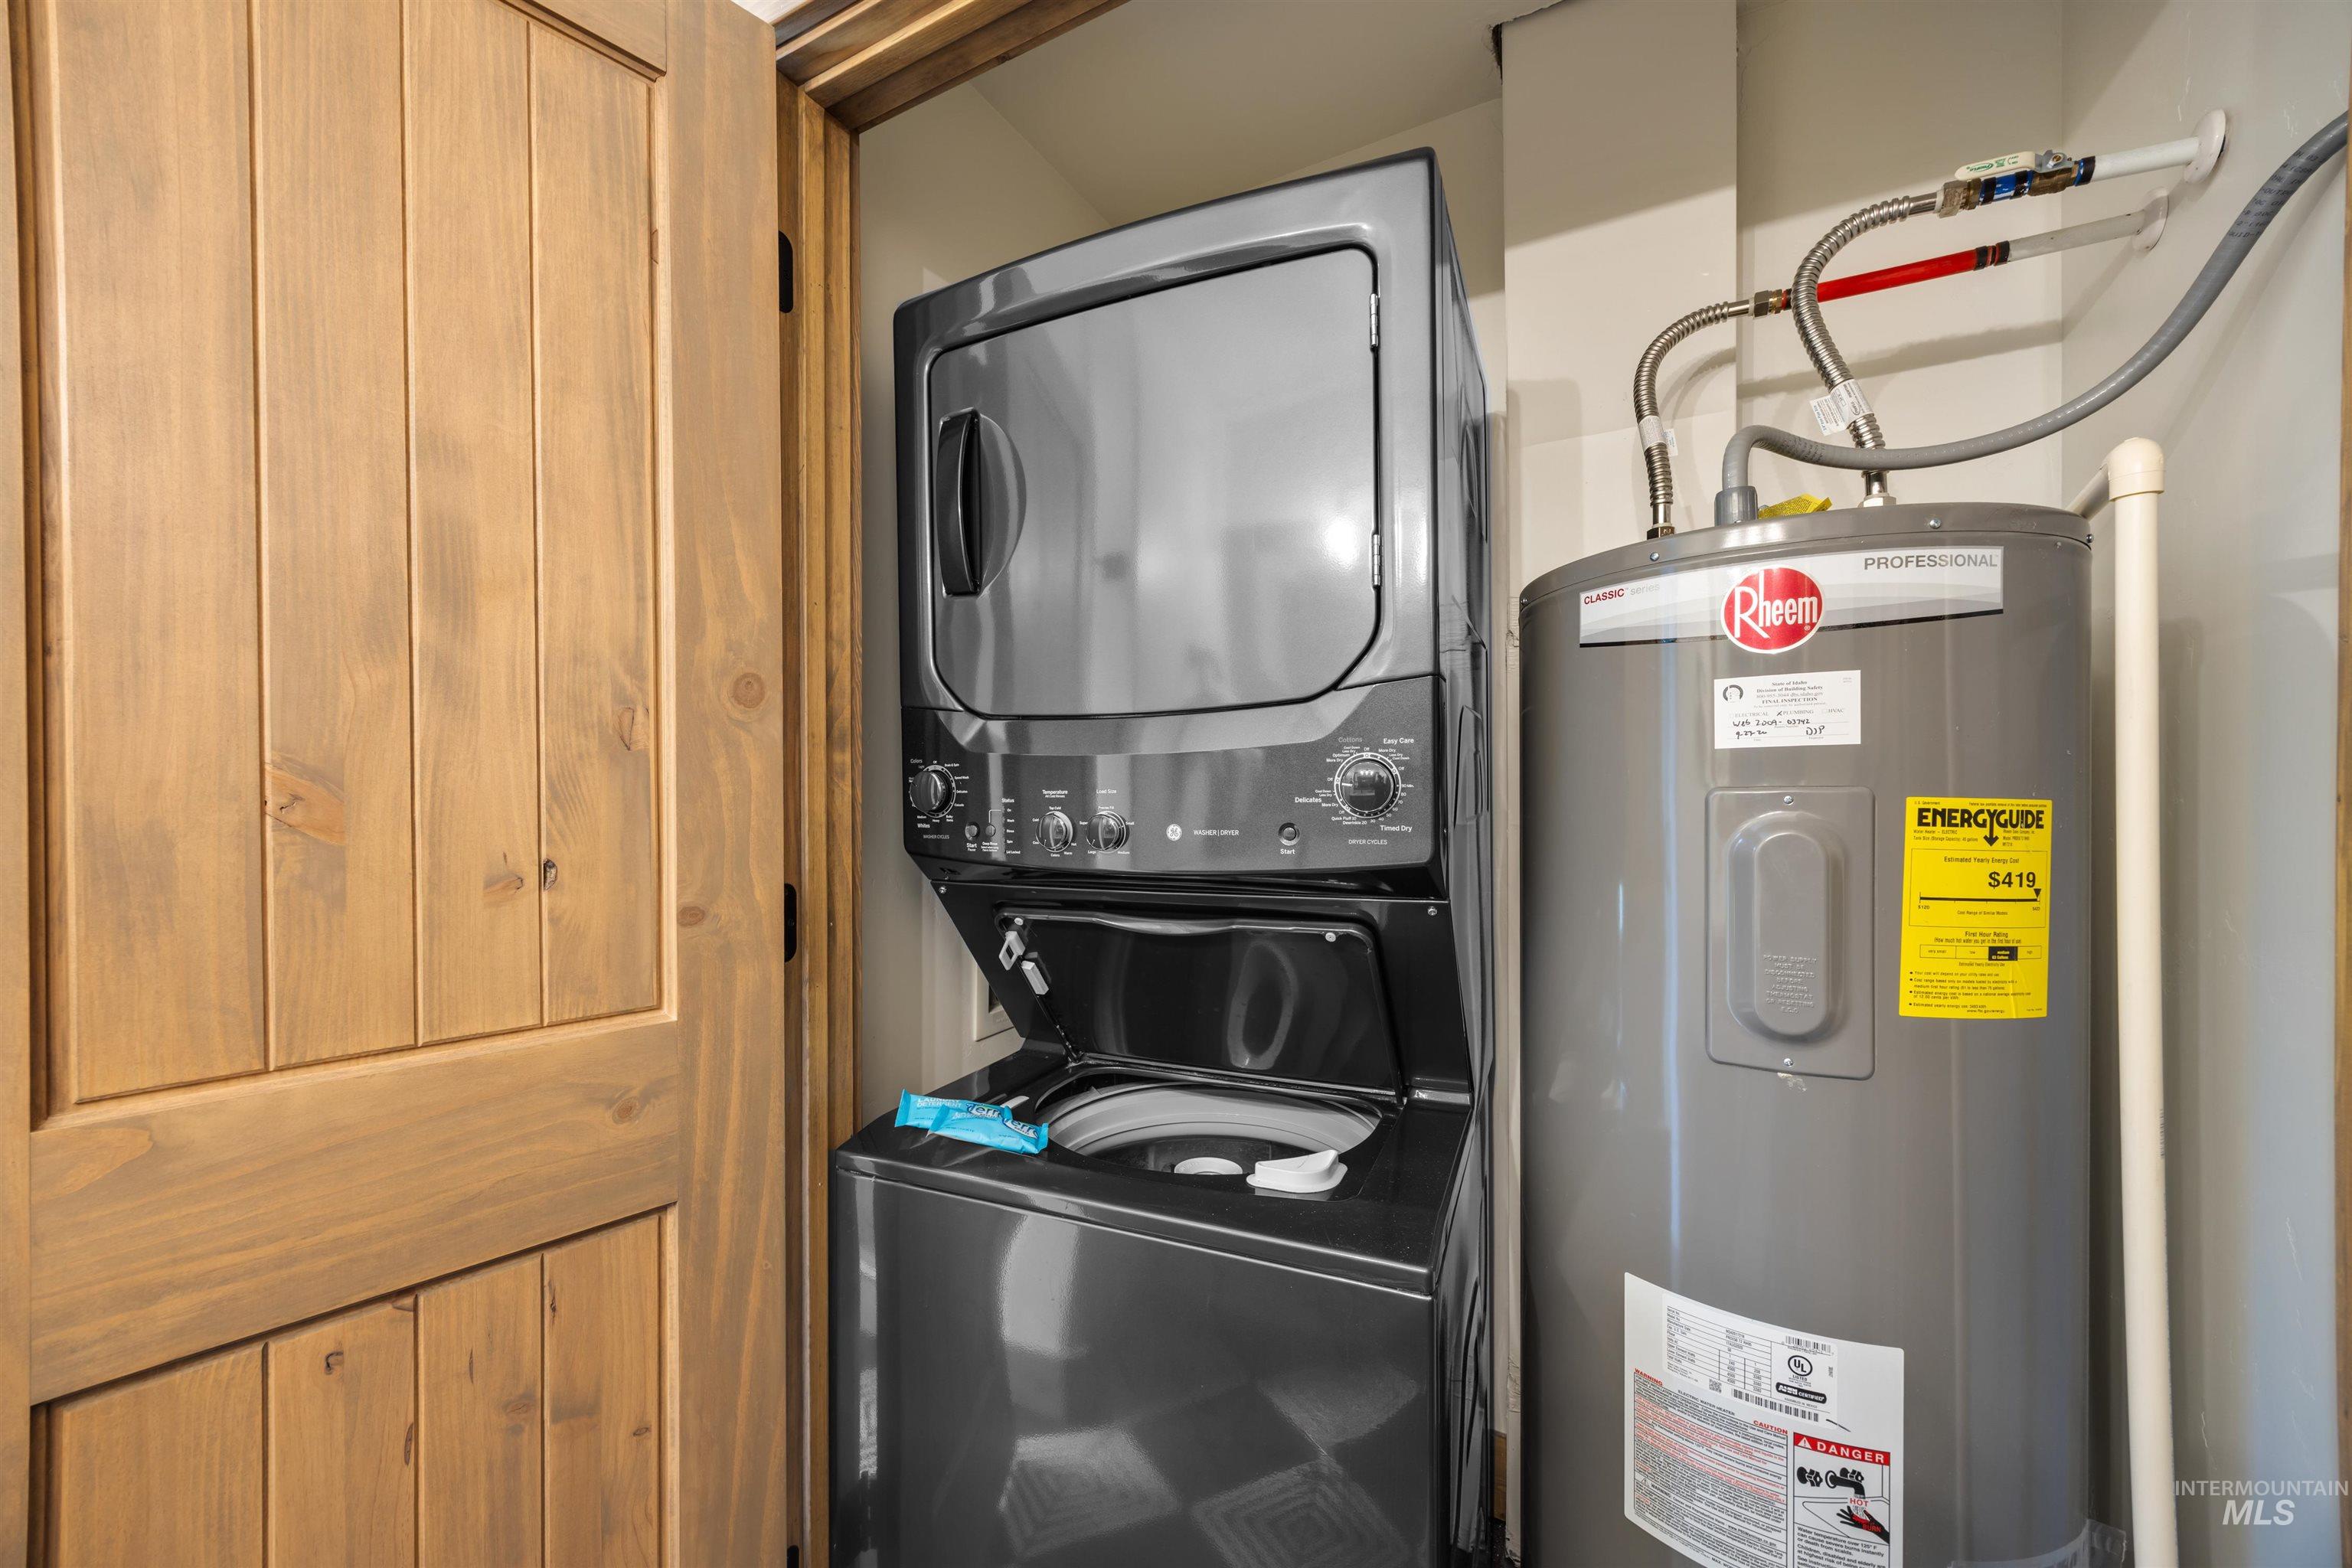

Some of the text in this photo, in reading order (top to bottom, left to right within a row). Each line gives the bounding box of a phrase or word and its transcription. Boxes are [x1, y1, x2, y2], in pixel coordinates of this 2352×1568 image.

[1864, 554, 1998, 570] PROFESSIONAL
[1583, 583, 1661, 605] CLASSIC series
[1734, 570, 1818, 639] Rheem
[1917, 807, 2045, 829] ENERGYGUIDE
[1988, 871, 2036, 890] $419
[1794, 1358, 1807, 1373] UL
[1634, 1367, 1664, 1387] WARNING
[1677, 1390, 1735, 1416] ELECTRIC WATER HEATER
[1753, 1419, 1788, 1435] CAUTION
[1817, 1441, 1884, 1464] DANGER
[1849, 1498, 1869, 1507] HOT
[1797, 1526, 1813, 1535] Water
[1814, 1531, 1847, 1544] temperature
[1862, 1523, 1881, 1532] BURN
[1803, 1550, 1824, 1560] highest
[1805, 1539, 1820, 1547] death
[1834, 1547, 1854, 1557] scalds.
[1808, 1535, 1824, 1544] cause
[1825, 1540, 1844, 1549] severe
[1861, 1547, 1884, 1557] instantly
[1797, 1544, 1822, 1555] Children,
[1822, 1551, 1846, 1561] disabled
[1858, 1560, 1876, 1568] elderly
